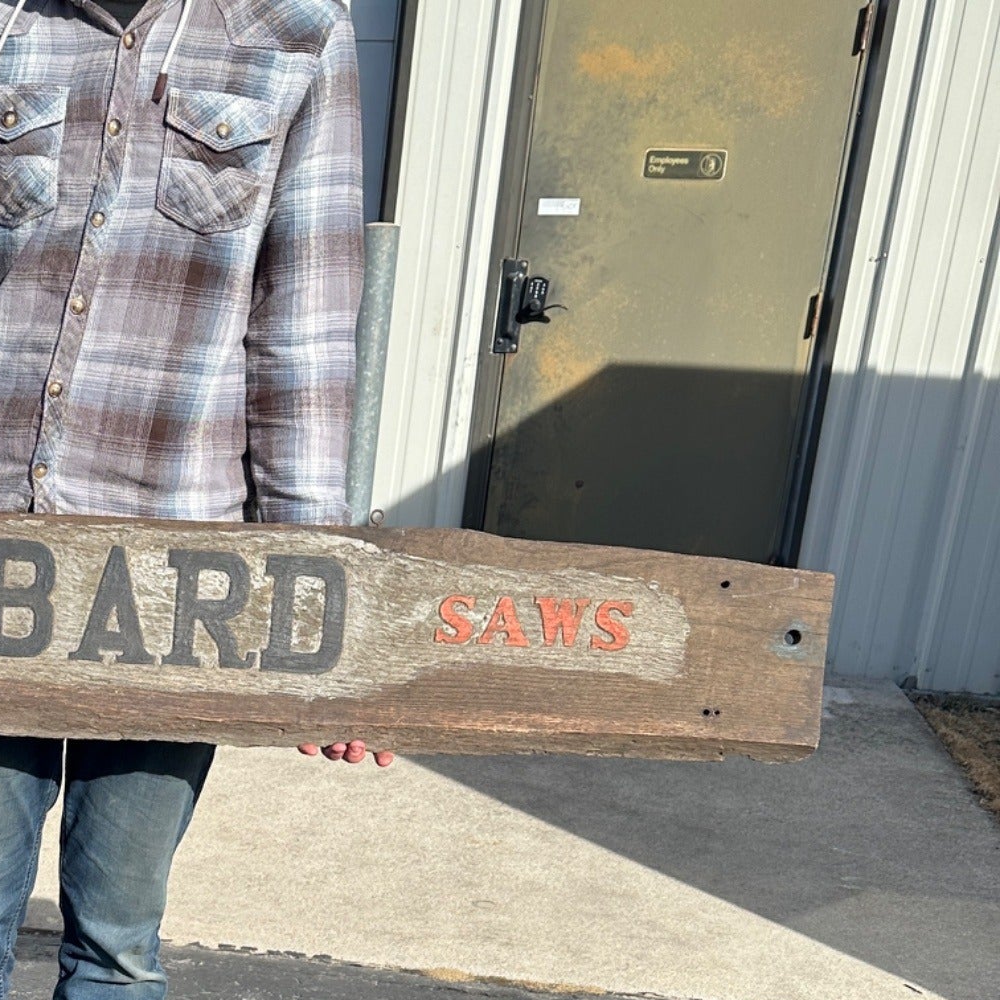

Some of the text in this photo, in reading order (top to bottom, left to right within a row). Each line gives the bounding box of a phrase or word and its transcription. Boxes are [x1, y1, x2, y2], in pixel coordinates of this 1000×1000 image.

[649, 155, 689, 166] Employees
[648, 165, 666, 174] Only
[434, 594, 634, 651] SAWS
